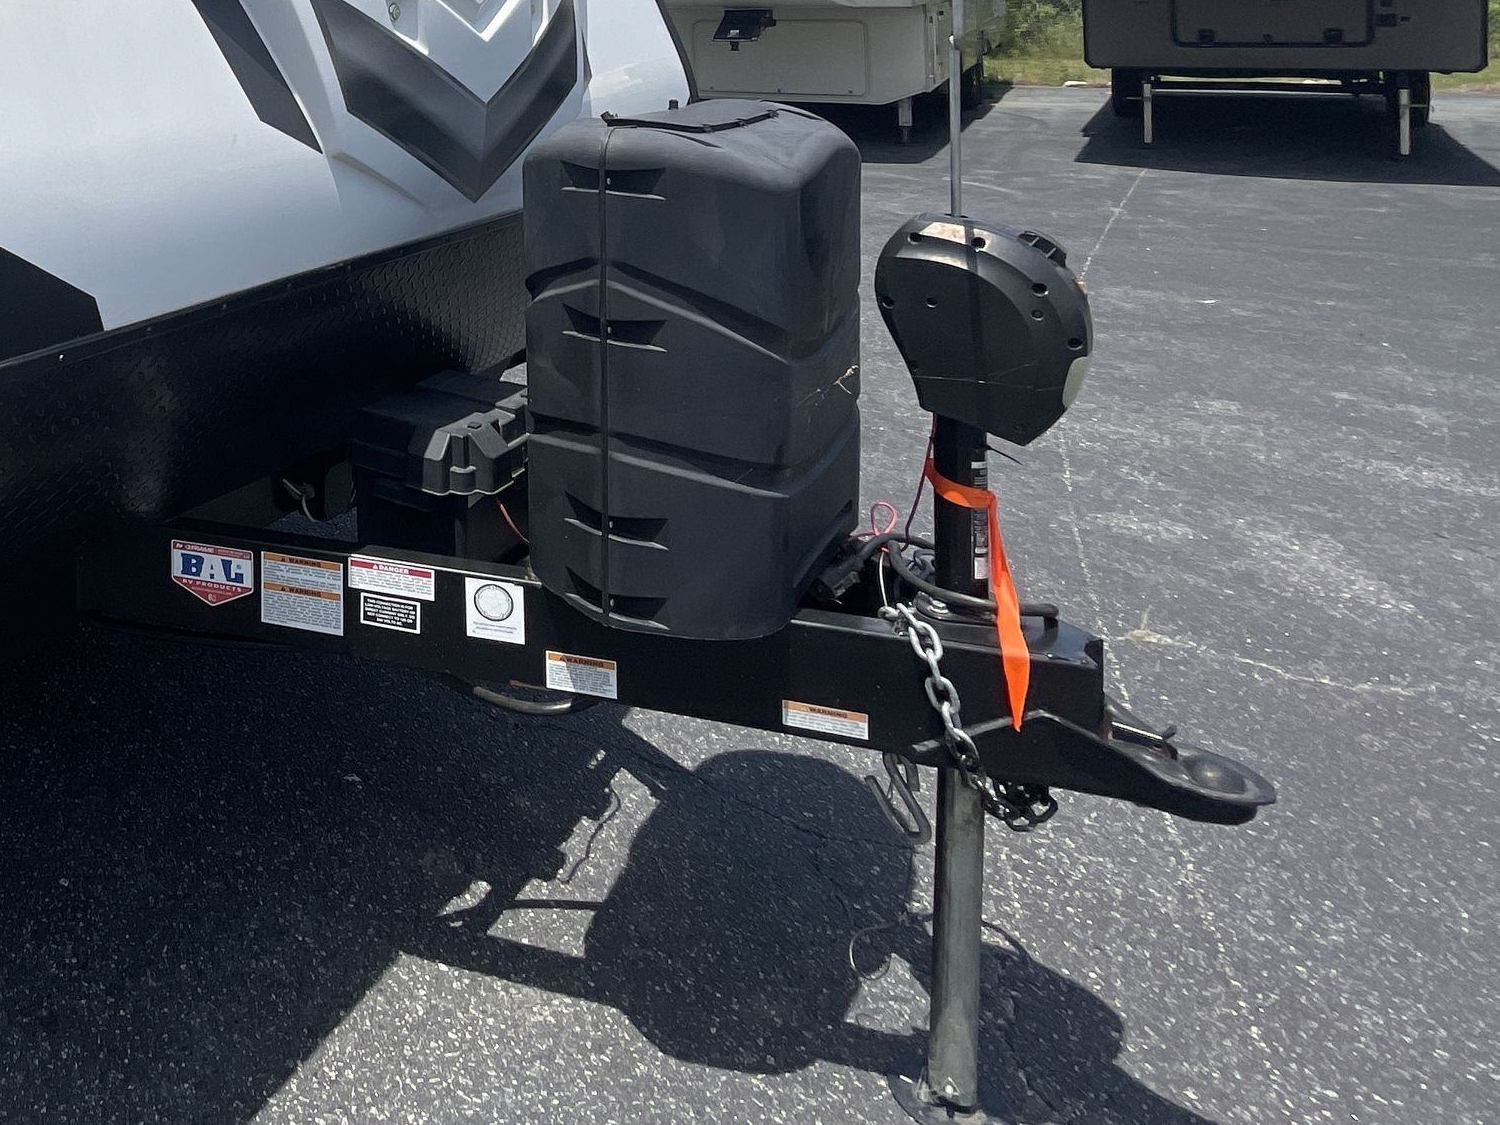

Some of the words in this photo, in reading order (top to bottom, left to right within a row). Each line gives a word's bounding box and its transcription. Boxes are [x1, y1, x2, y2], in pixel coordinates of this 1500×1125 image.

[180, 553, 244, 584] BAL
[379, 564, 409, 575] DANGER
[196, 580, 242, 593] PRODUCTS
